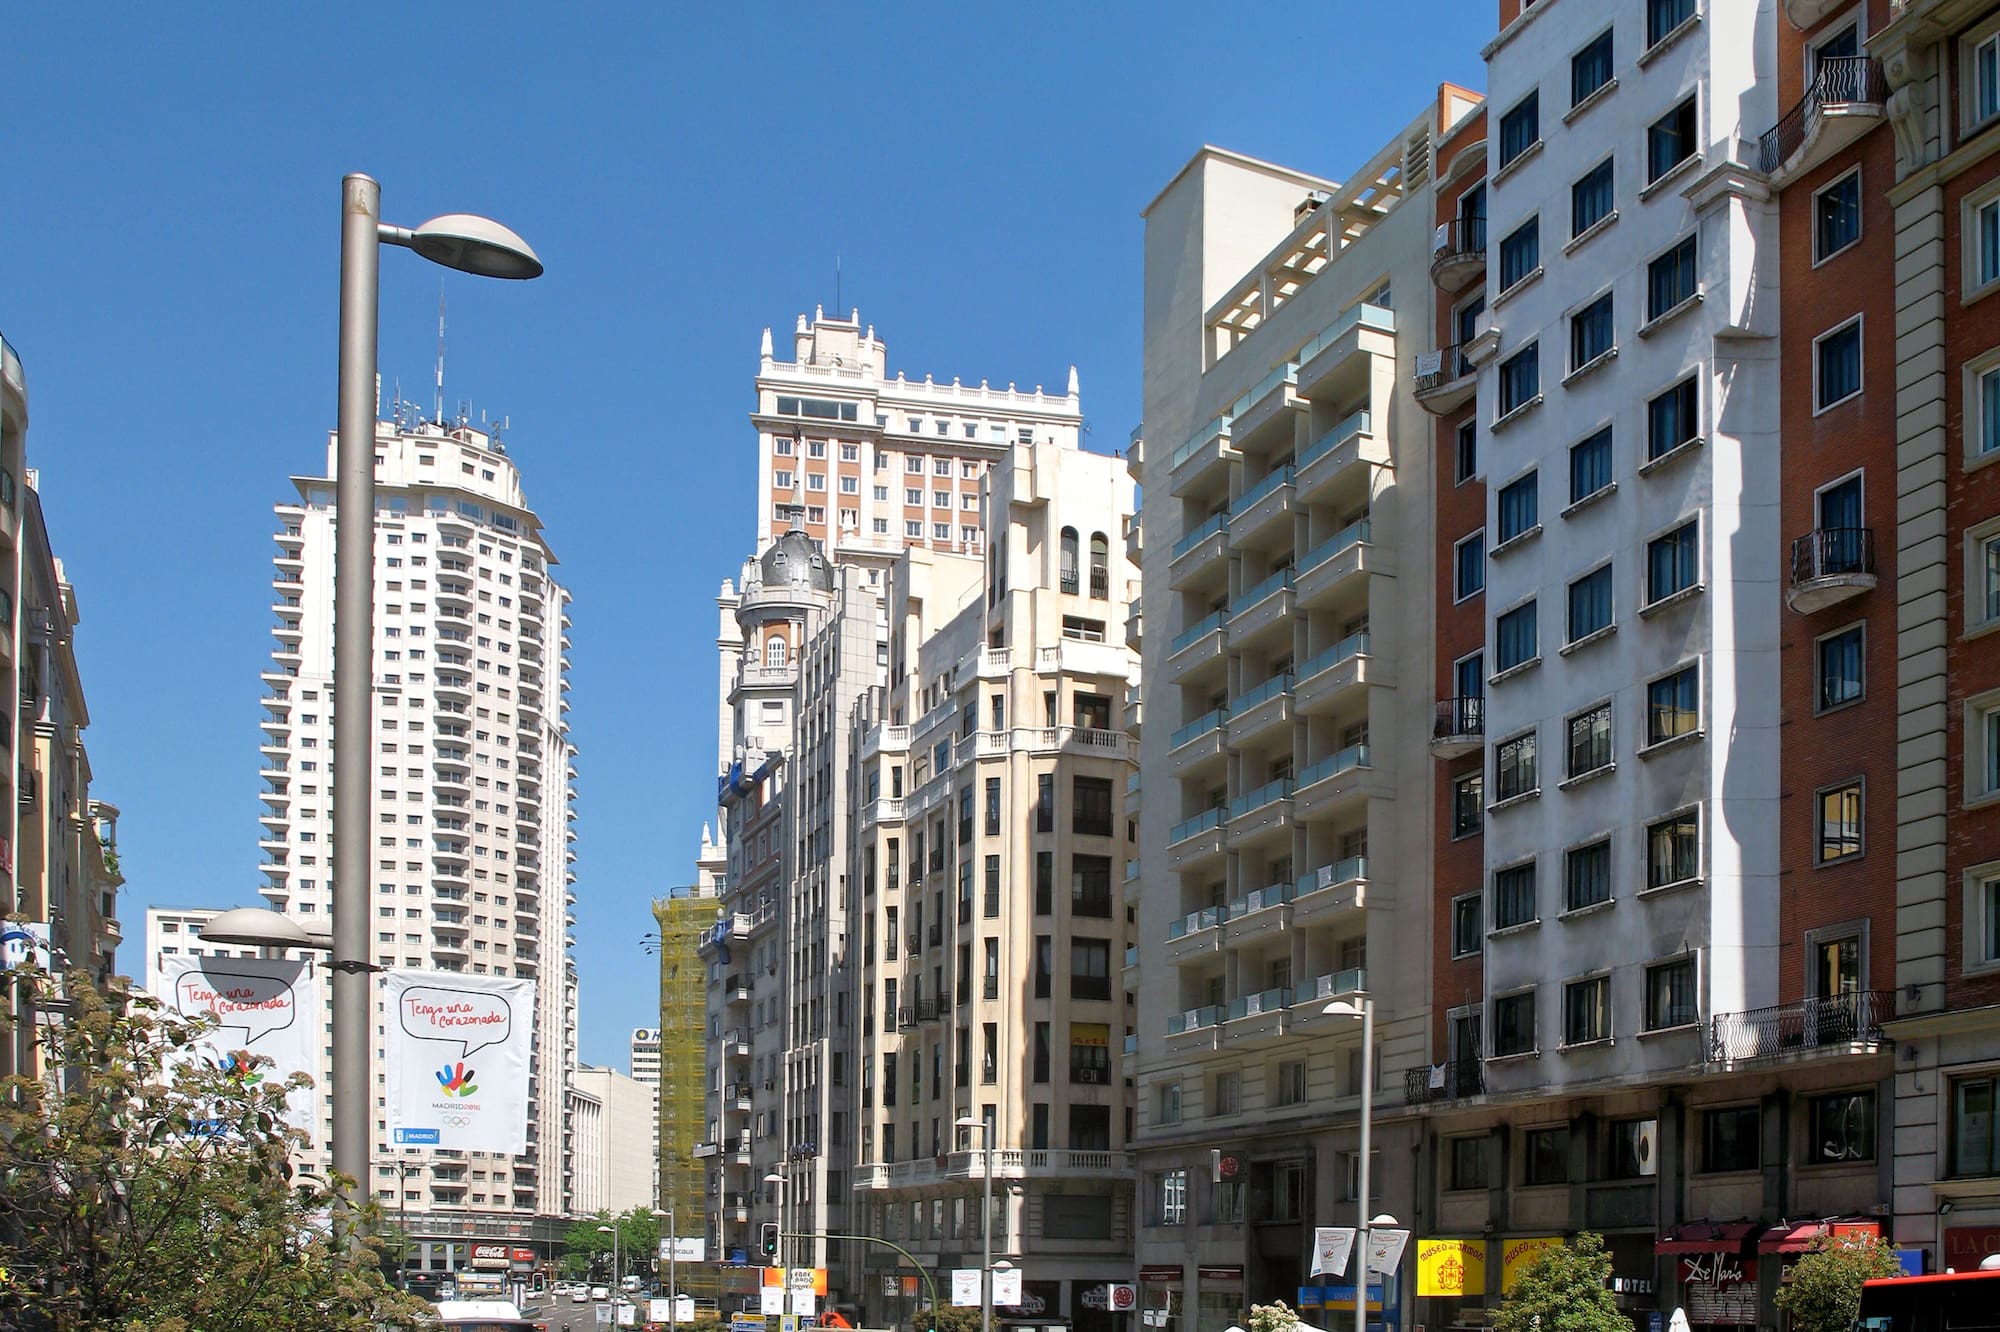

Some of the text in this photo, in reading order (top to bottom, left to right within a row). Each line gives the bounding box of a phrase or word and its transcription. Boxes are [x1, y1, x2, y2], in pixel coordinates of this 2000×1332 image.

[182, 983, 254, 1011] Tengo una
[405, 999, 474, 1025] Tengo una
[1420, 1243, 1447, 1262] MUSEO
[1615, 1278, 1652, 1293] HOTEL
